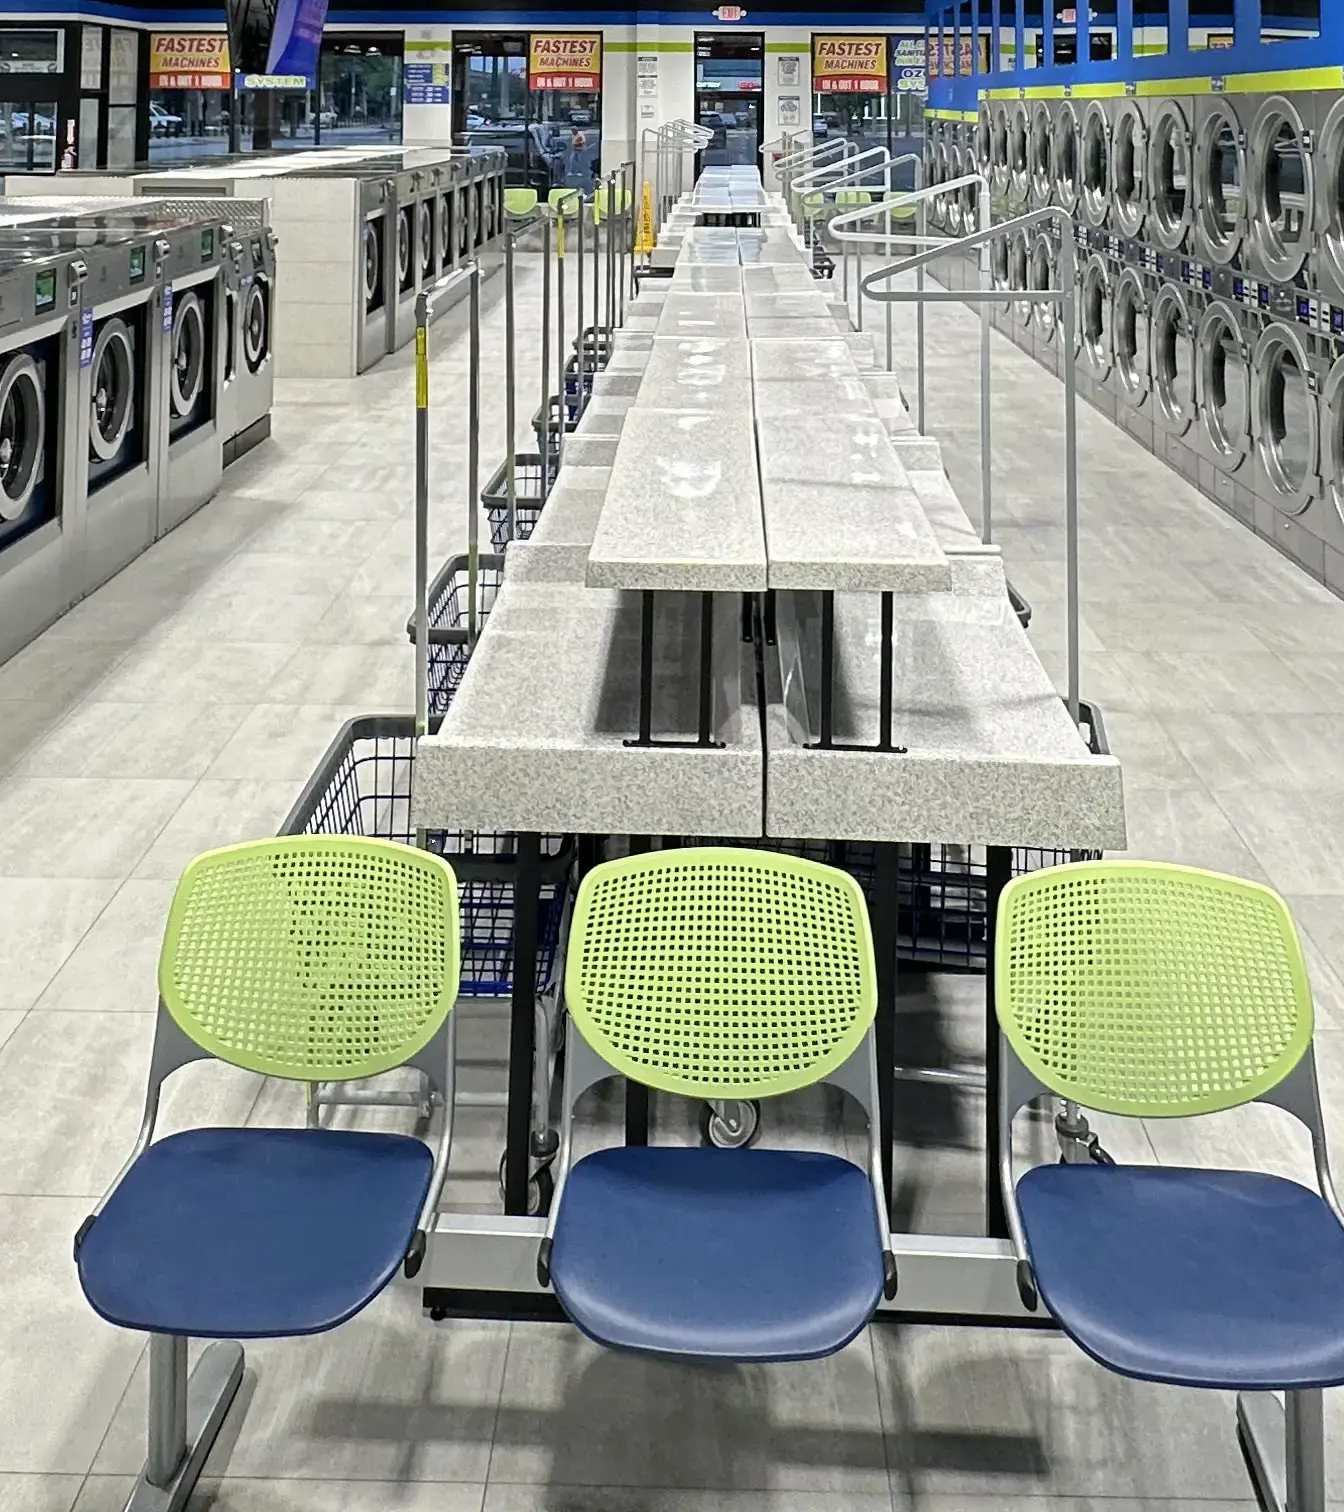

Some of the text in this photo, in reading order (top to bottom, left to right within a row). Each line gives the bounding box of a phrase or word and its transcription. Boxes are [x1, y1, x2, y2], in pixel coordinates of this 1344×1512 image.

[155, 38, 227, 53] FASTEST
[533, 39, 597, 54] FASTEST
[817, 42, 882, 56] FASTEST
[161, 56, 220, 68] MACHINES
[539, 57, 591, 68] MACHINES
[824, 59, 877, 70] MACHINES
[159, 74, 168, 87] IN
[177, 74, 193, 87] OUT
[242, 74, 306, 88] SYSTEM
[537, 77, 545, 88] IN
[553, 77, 566, 88] OUT
[822, 80, 831, 90] IN
[838, 80, 852, 90] OUT
